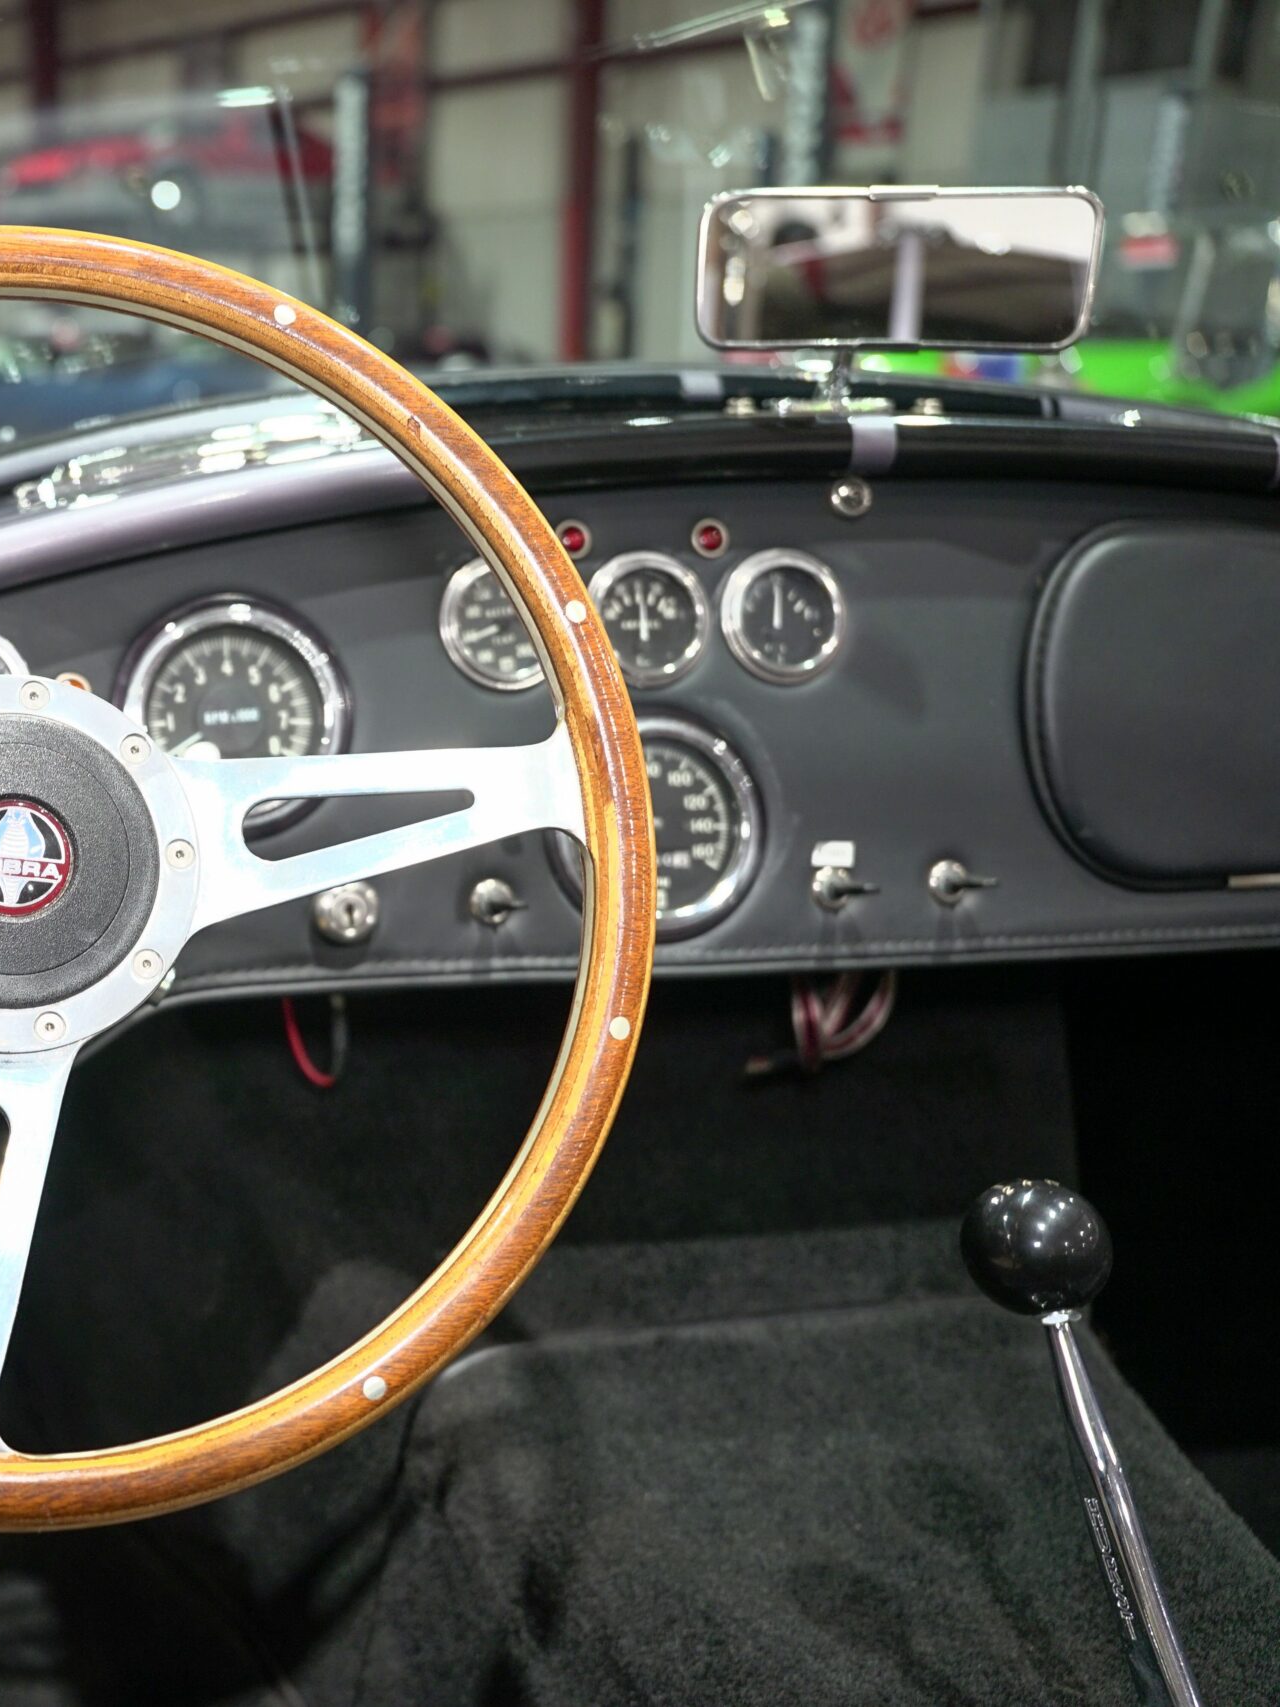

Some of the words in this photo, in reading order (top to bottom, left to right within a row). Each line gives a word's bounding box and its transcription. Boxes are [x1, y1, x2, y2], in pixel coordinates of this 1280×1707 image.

[194, 666, 207, 685] 3
[248, 665, 261, 686] 5
[174, 683, 186, 703] 2
[167, 712, 175, 732] 1
[278, 709, 289, 730] 7
[667, 765, 694, 787] 100
[683, 790, 708, 811] 120
[690, 816, 713, 835] 140
[692, 842, 715, 859] 160
[1084, 1497, 1137, 1640] HURST
